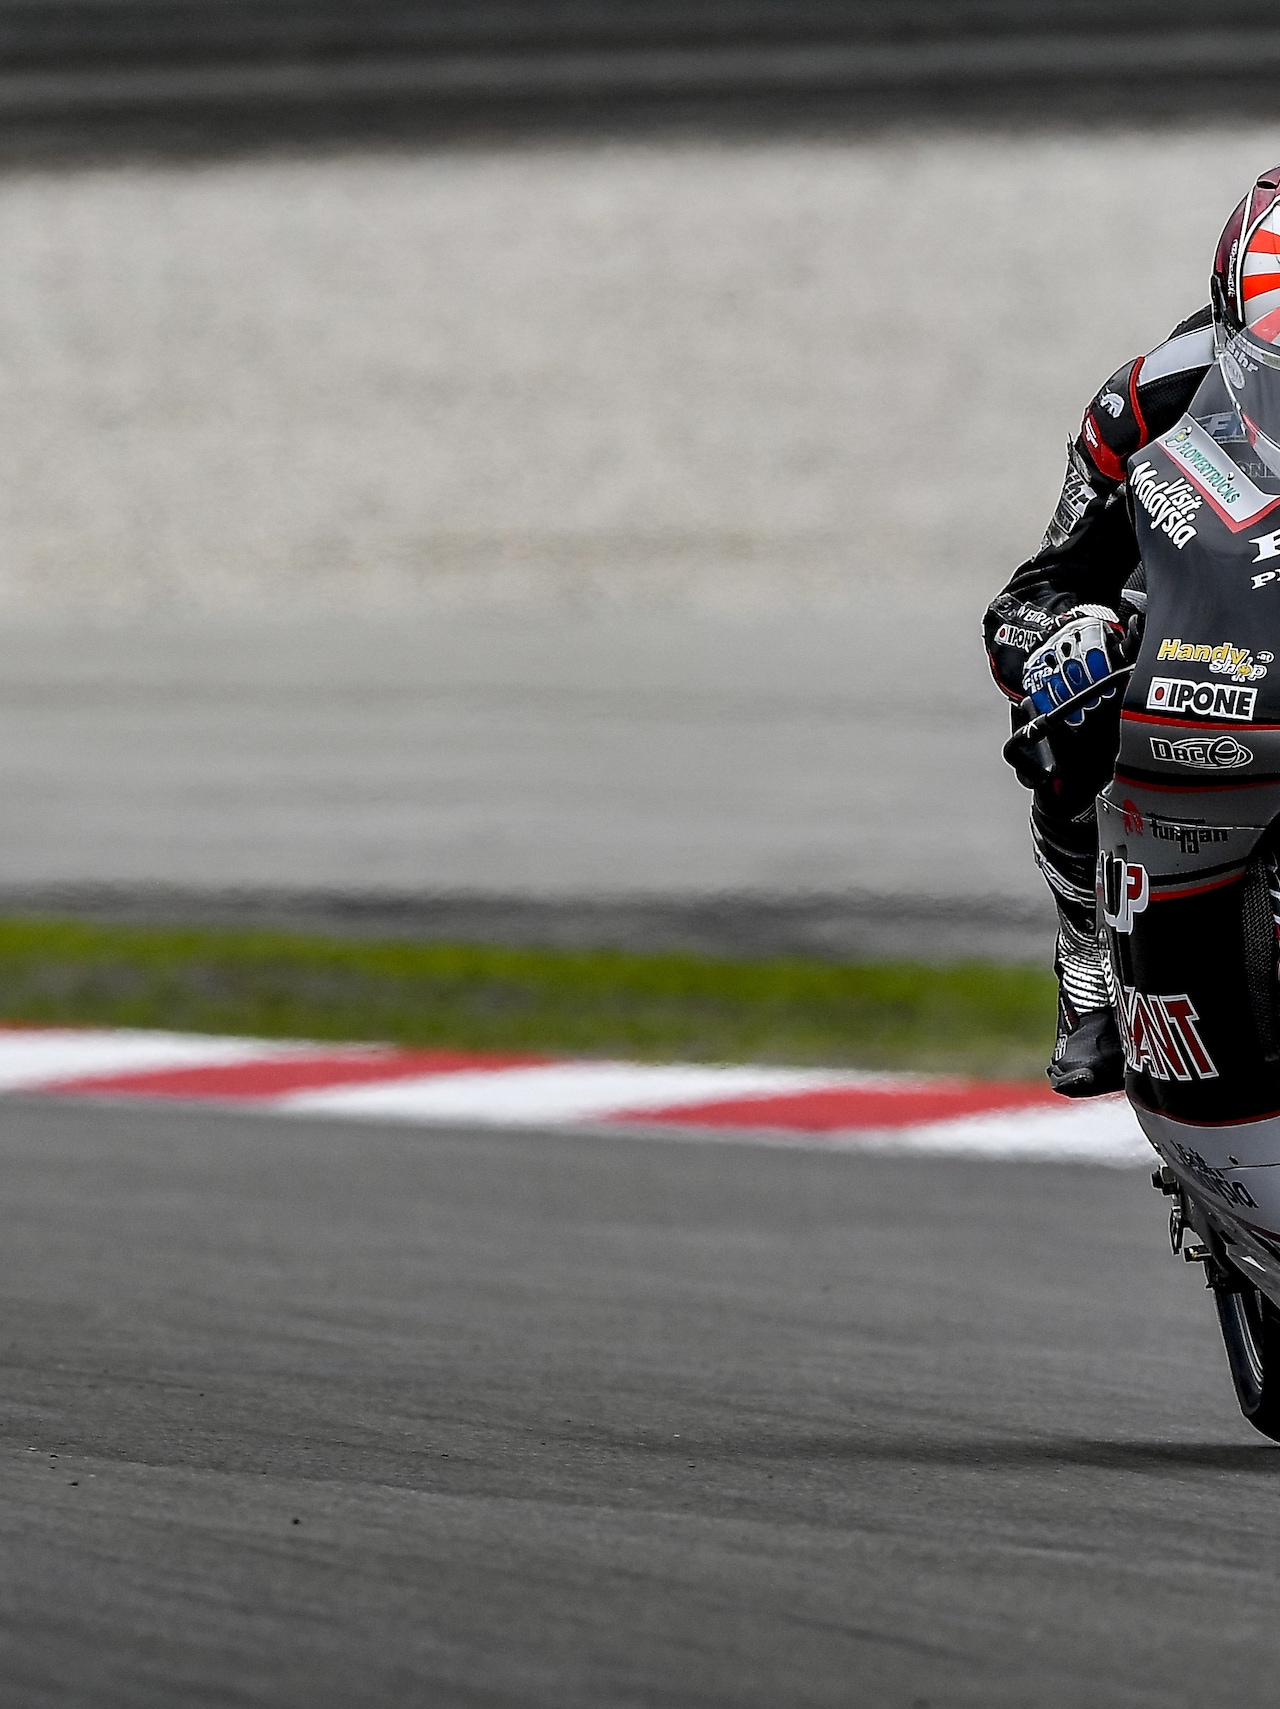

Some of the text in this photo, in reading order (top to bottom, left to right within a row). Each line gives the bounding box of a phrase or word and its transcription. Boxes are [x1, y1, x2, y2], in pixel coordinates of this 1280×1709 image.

[1176, 441, 1241, 504] FLOWERTRUCKS
[1129, 460, 1198, 550] Malaysia
[1163, 477, 1203, 516] Visit
[1156, 639, 1251, 665] Handy
[1167, 682, 1254, 718] IPONE
